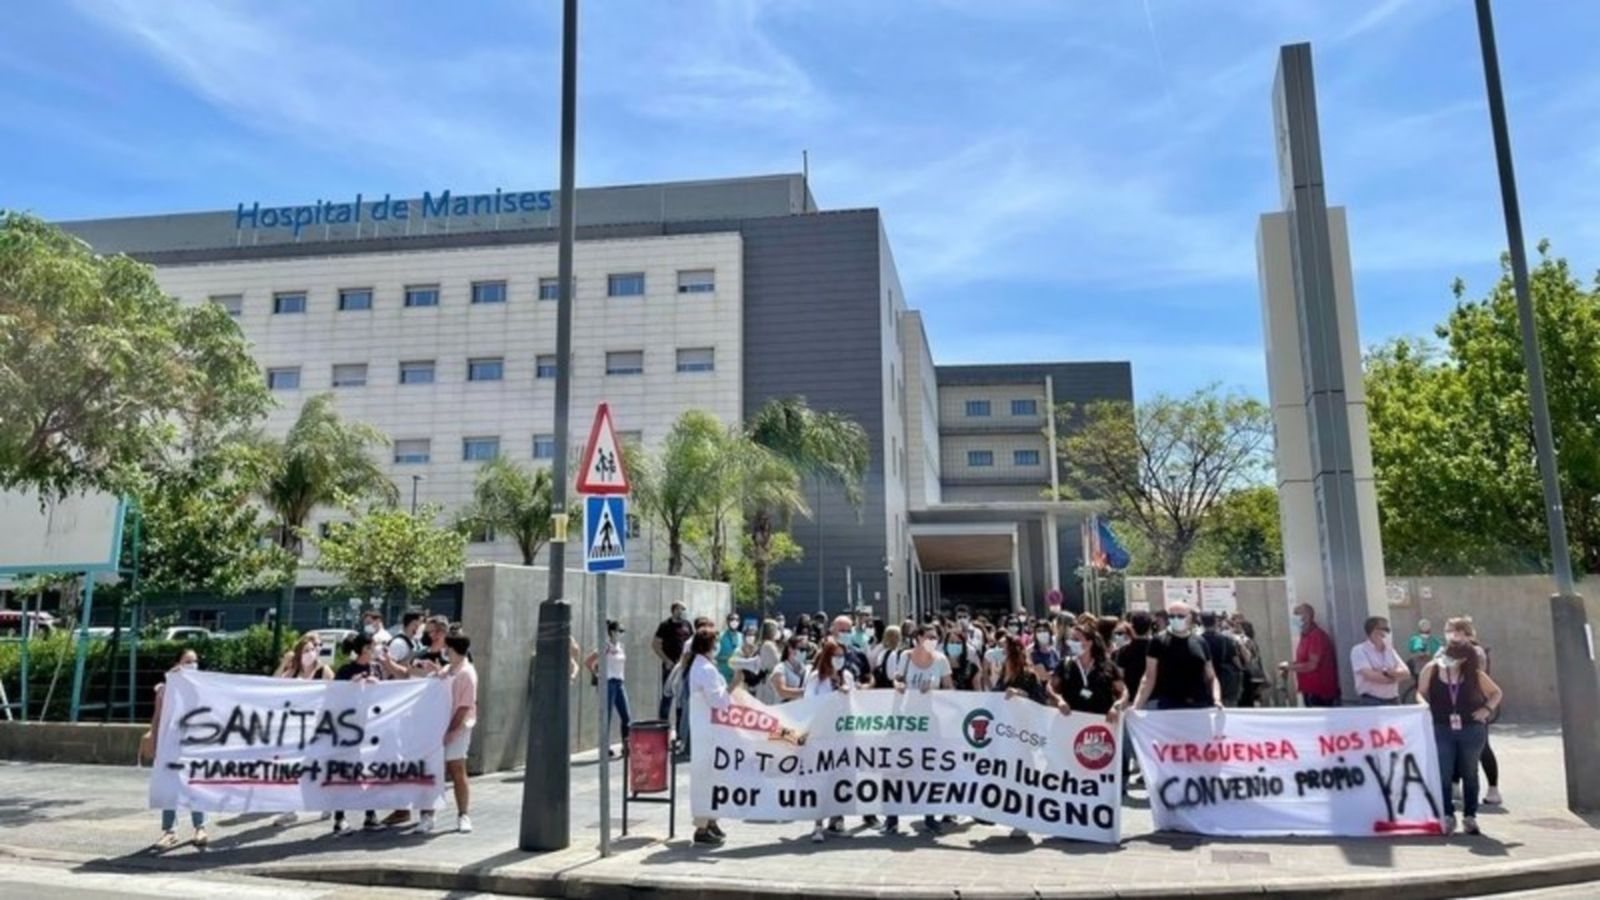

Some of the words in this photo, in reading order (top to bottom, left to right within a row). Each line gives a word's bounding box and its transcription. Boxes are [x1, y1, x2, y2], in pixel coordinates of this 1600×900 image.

[236, 193, 362, 236] Hospital
[371, 194, 409, 221] de
[422, 188, 554, 218] Manises
[835, 715, 929, 732] CEMSATSE
[1319, 733, 1365, 755] NOS
[1371, 728, 1405, 748] DA
[326, 760, 435, 781] PERSONAL
[963, 752, 1008, 779] "en
[1014, 760, 1116, 797] lucha"
[711, 785, 761, 811] por
[778, 788, 817, 808] un
[1158, 766, 1284, 810] CONVENIO
[1294, 757, 1366, 797] PROPIO
[1365, 751, 1441, 823] YA
